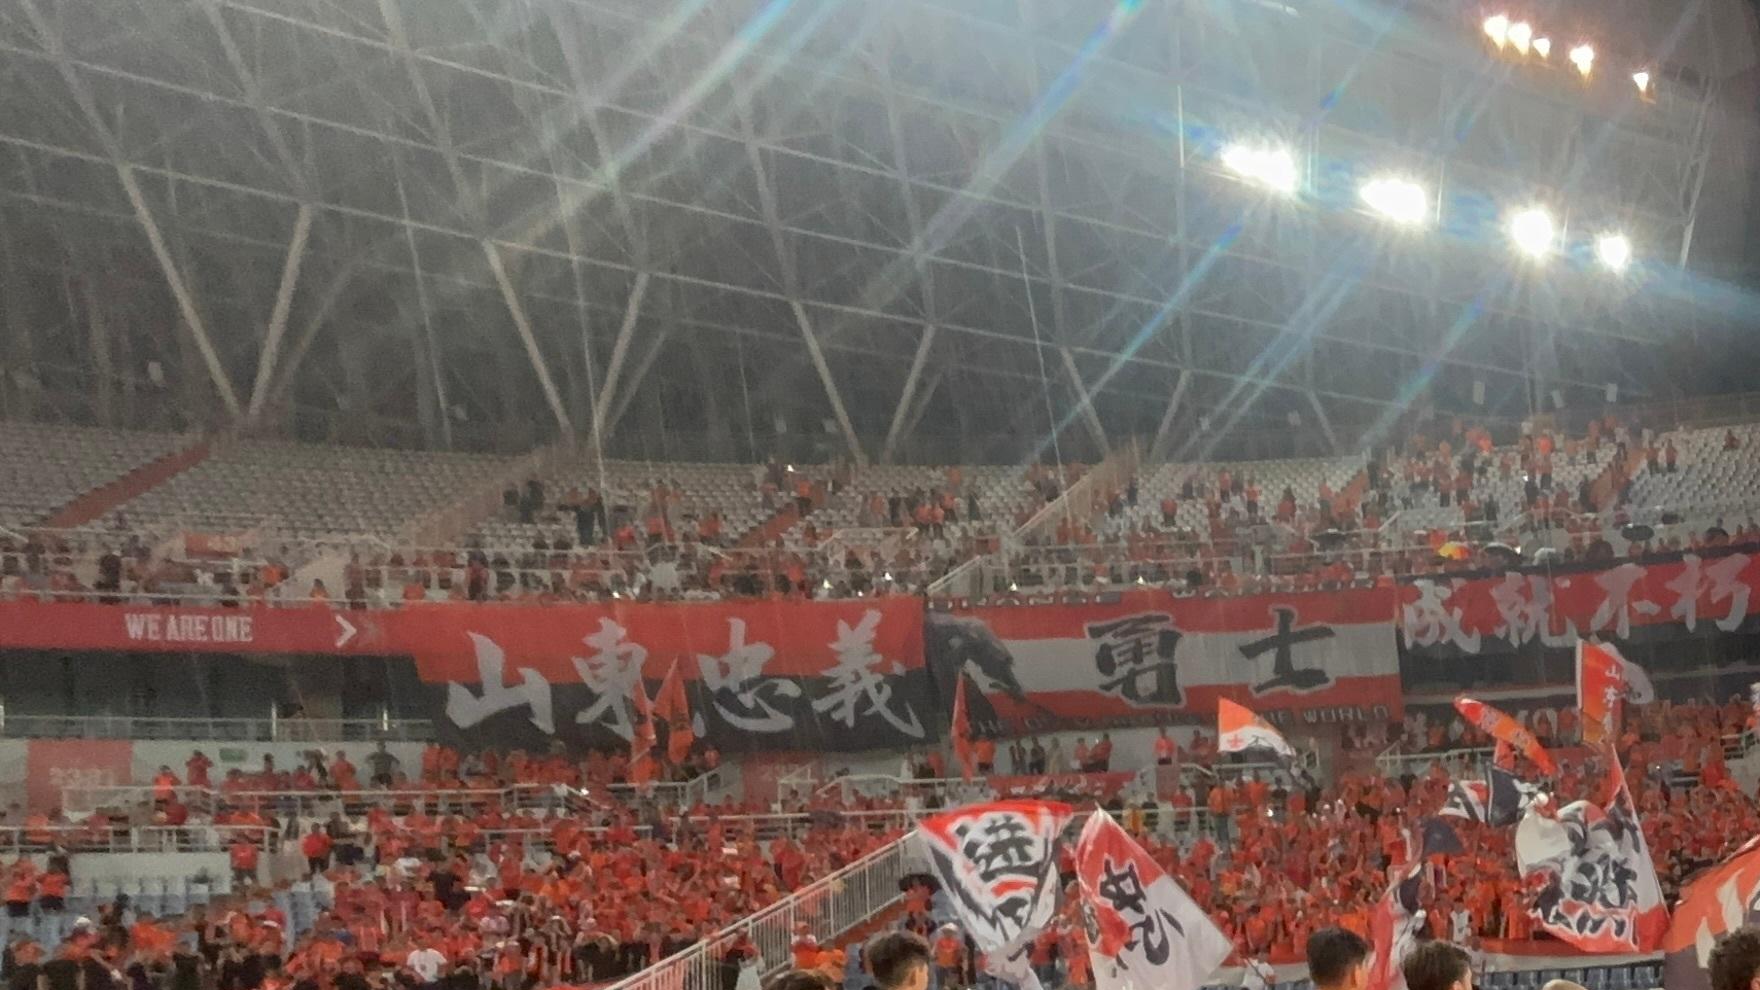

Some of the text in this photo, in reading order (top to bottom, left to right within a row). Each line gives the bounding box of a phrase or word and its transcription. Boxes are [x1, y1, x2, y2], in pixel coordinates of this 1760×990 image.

[124, 613, 253, 642] WE ARE ONE
